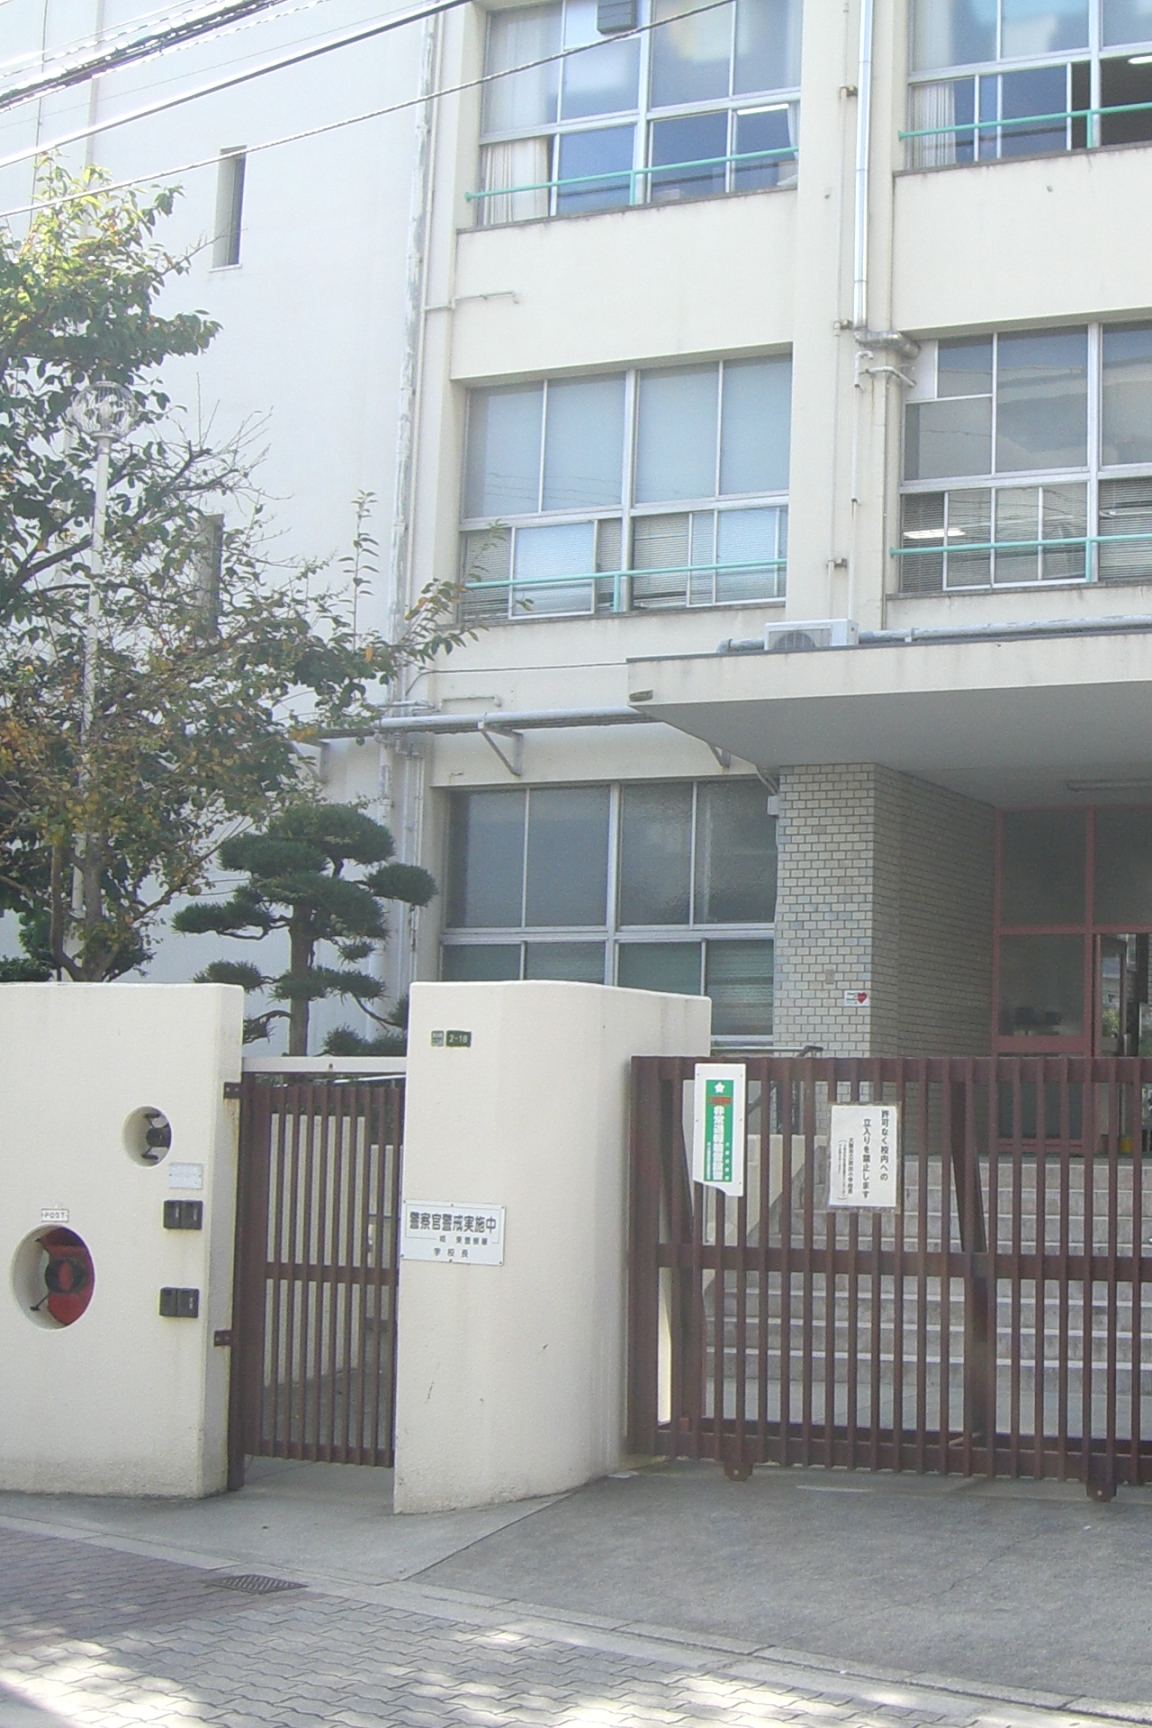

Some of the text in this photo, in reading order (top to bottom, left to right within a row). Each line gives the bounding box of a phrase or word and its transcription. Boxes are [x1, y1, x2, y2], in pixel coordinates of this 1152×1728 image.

[410, 1211, 497, 1234] 警察官警戒実施中
